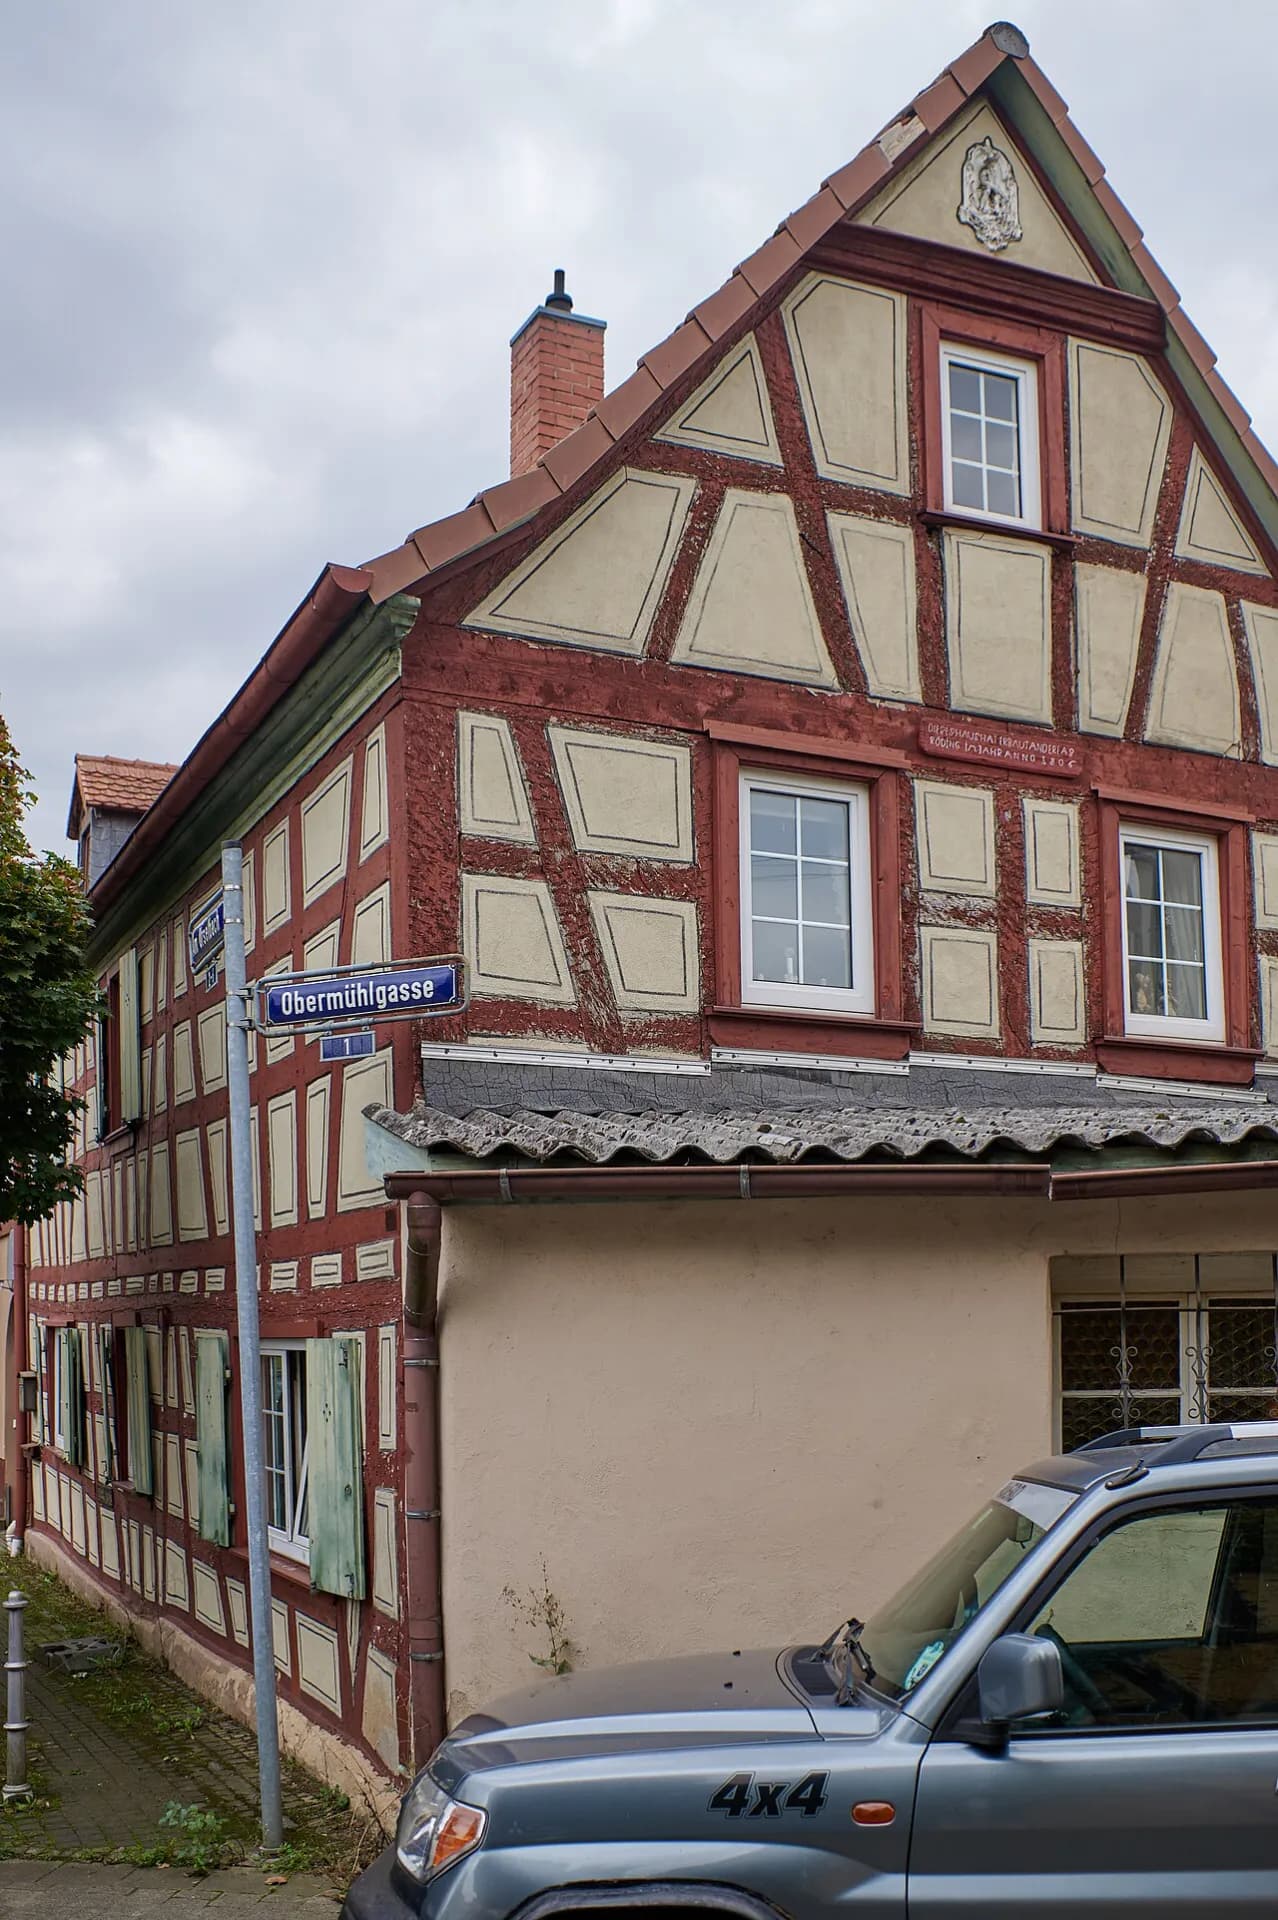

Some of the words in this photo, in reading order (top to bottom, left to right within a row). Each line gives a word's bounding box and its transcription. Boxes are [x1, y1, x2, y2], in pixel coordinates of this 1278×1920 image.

[1004, 750, 1036, 762] ANNO
[281, 978, 434, 1016] Obermühlgasse
[343, 1038, 350, 1056] 1
[708, 1770, 830, 1818] 4x4
